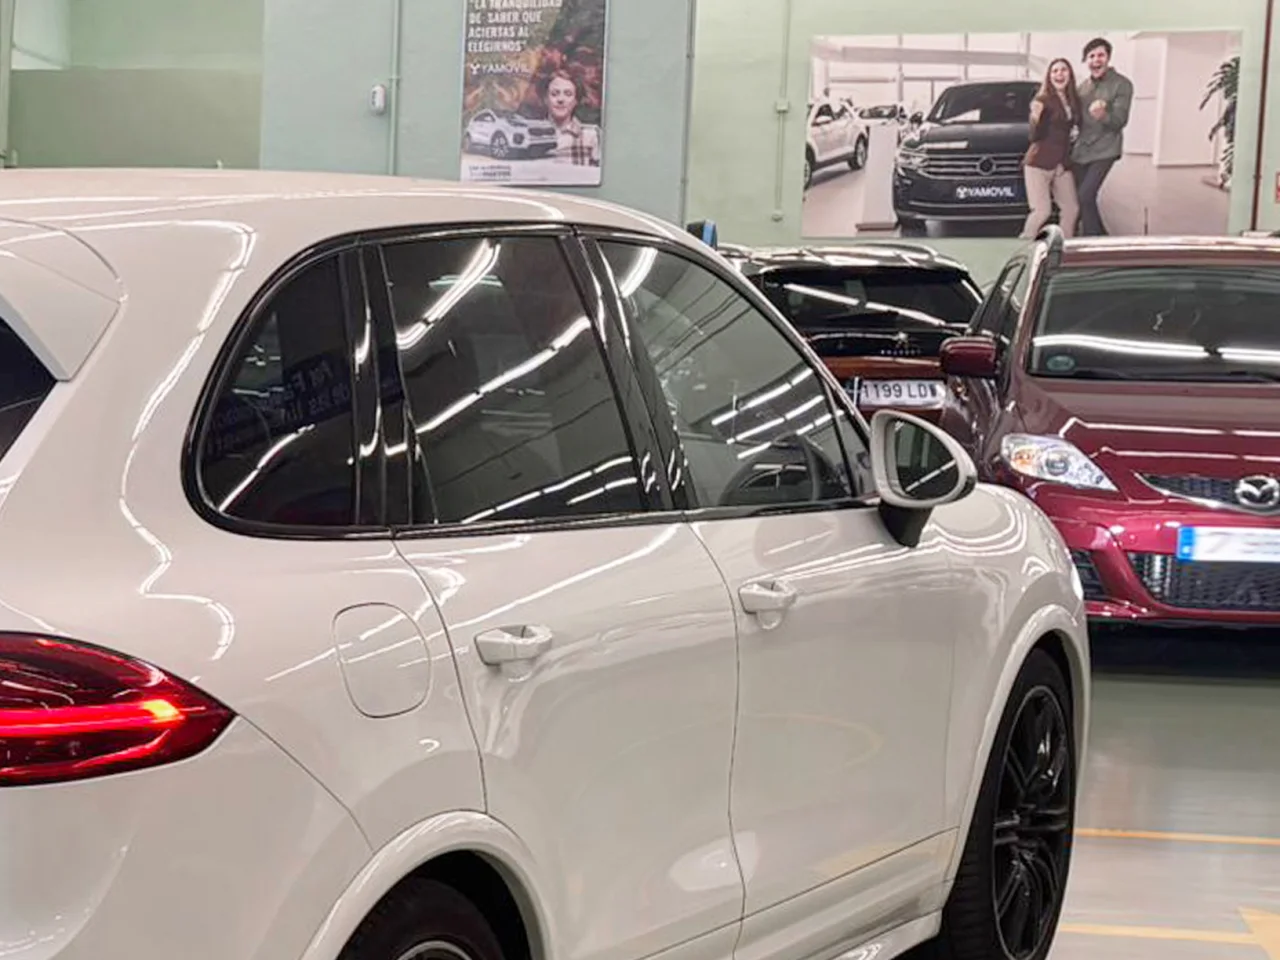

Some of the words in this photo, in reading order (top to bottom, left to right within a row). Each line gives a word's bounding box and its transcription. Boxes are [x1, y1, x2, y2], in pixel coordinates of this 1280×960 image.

[469, 11, 482, 24] DE
[487, 11, 520, 24] SABER
[522, 10, 543, 24] QUE
[468, 26, 516, 38] ACIERTAS
[968, 185, 1015, 198] YAMOVIL
[863, 383, 903, 399] 1199
